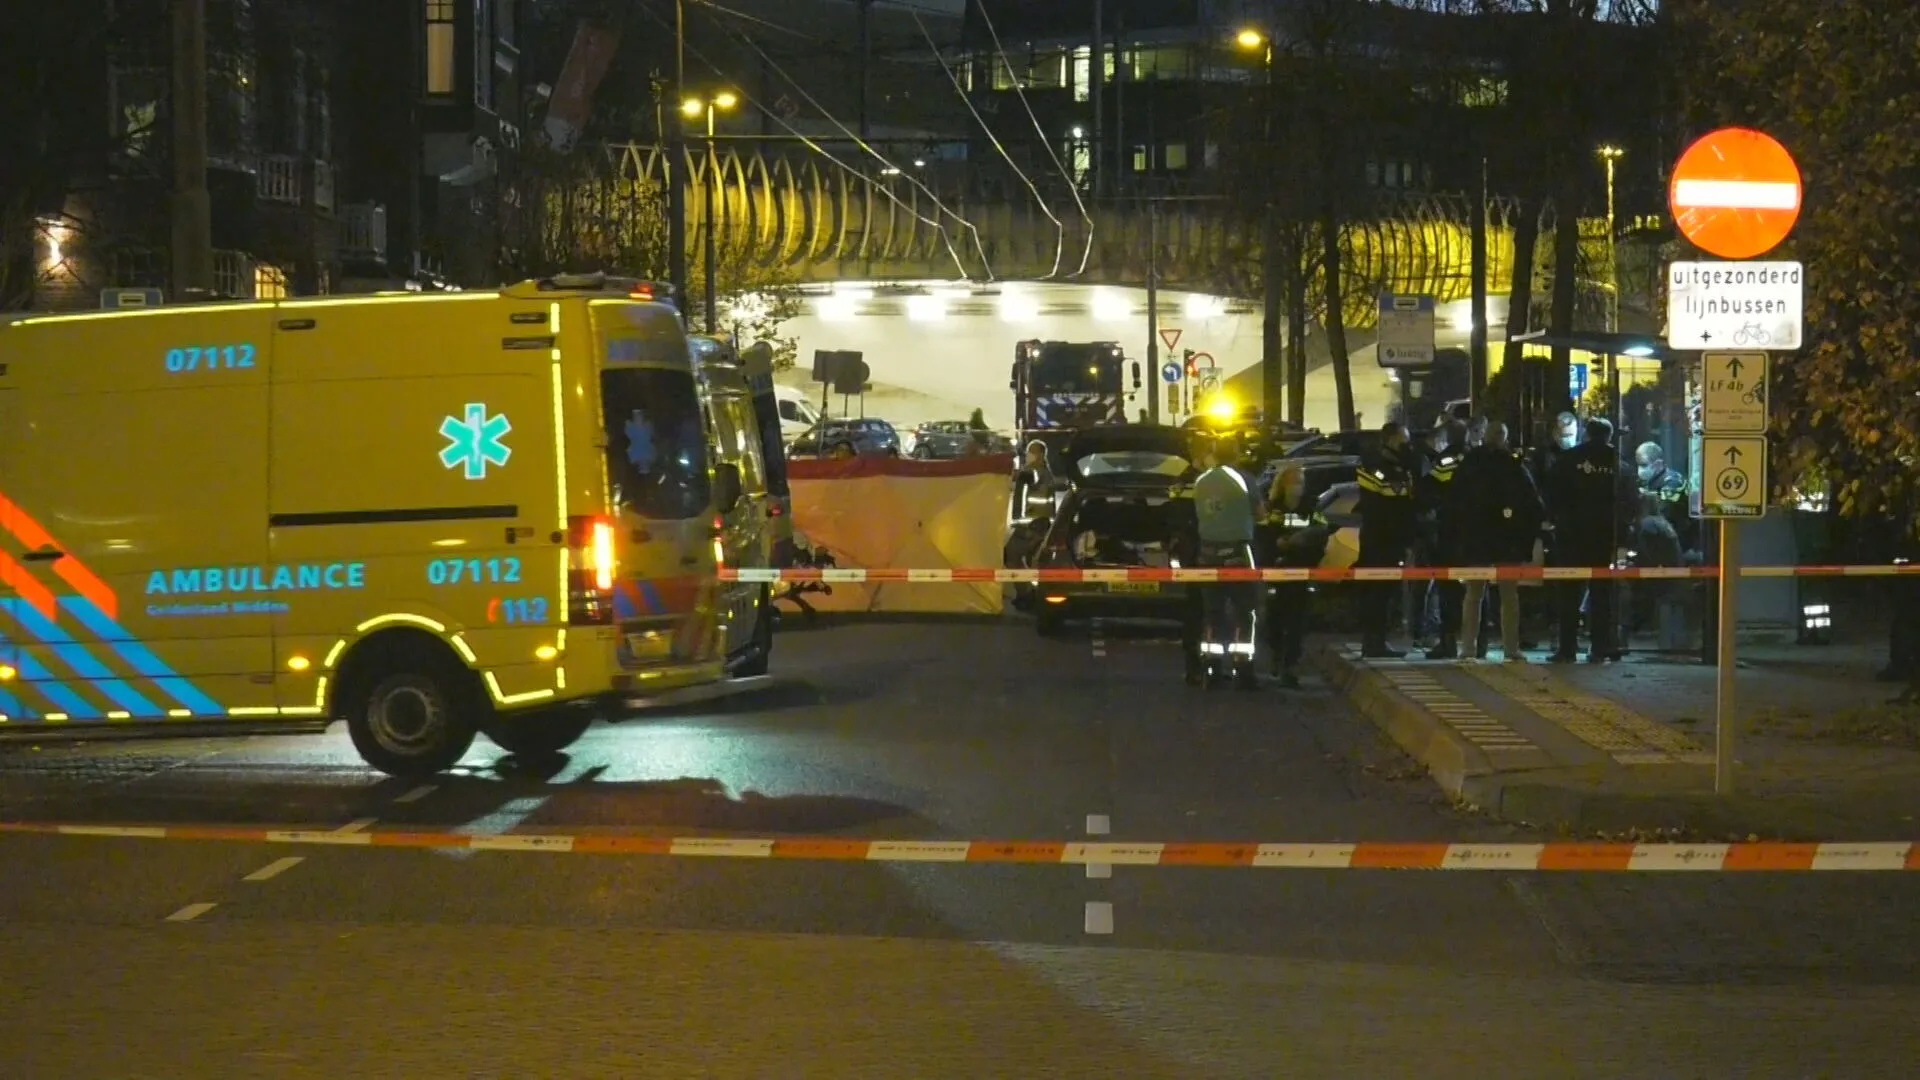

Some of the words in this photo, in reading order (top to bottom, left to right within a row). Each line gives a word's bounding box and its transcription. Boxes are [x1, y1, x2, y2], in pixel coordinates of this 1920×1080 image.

[1673, 267, 1799, 290] uitgezonderd
[1686, 295, 1786, 319] lijnbussen
[165, 344, 256, 372] 07112
[1722, 475, 1744, 490] 69
[145, 563, 365, 594] AMBULANCE
[427, 557, 521, 585] 07112
[502, 597, 548, 623] 112
